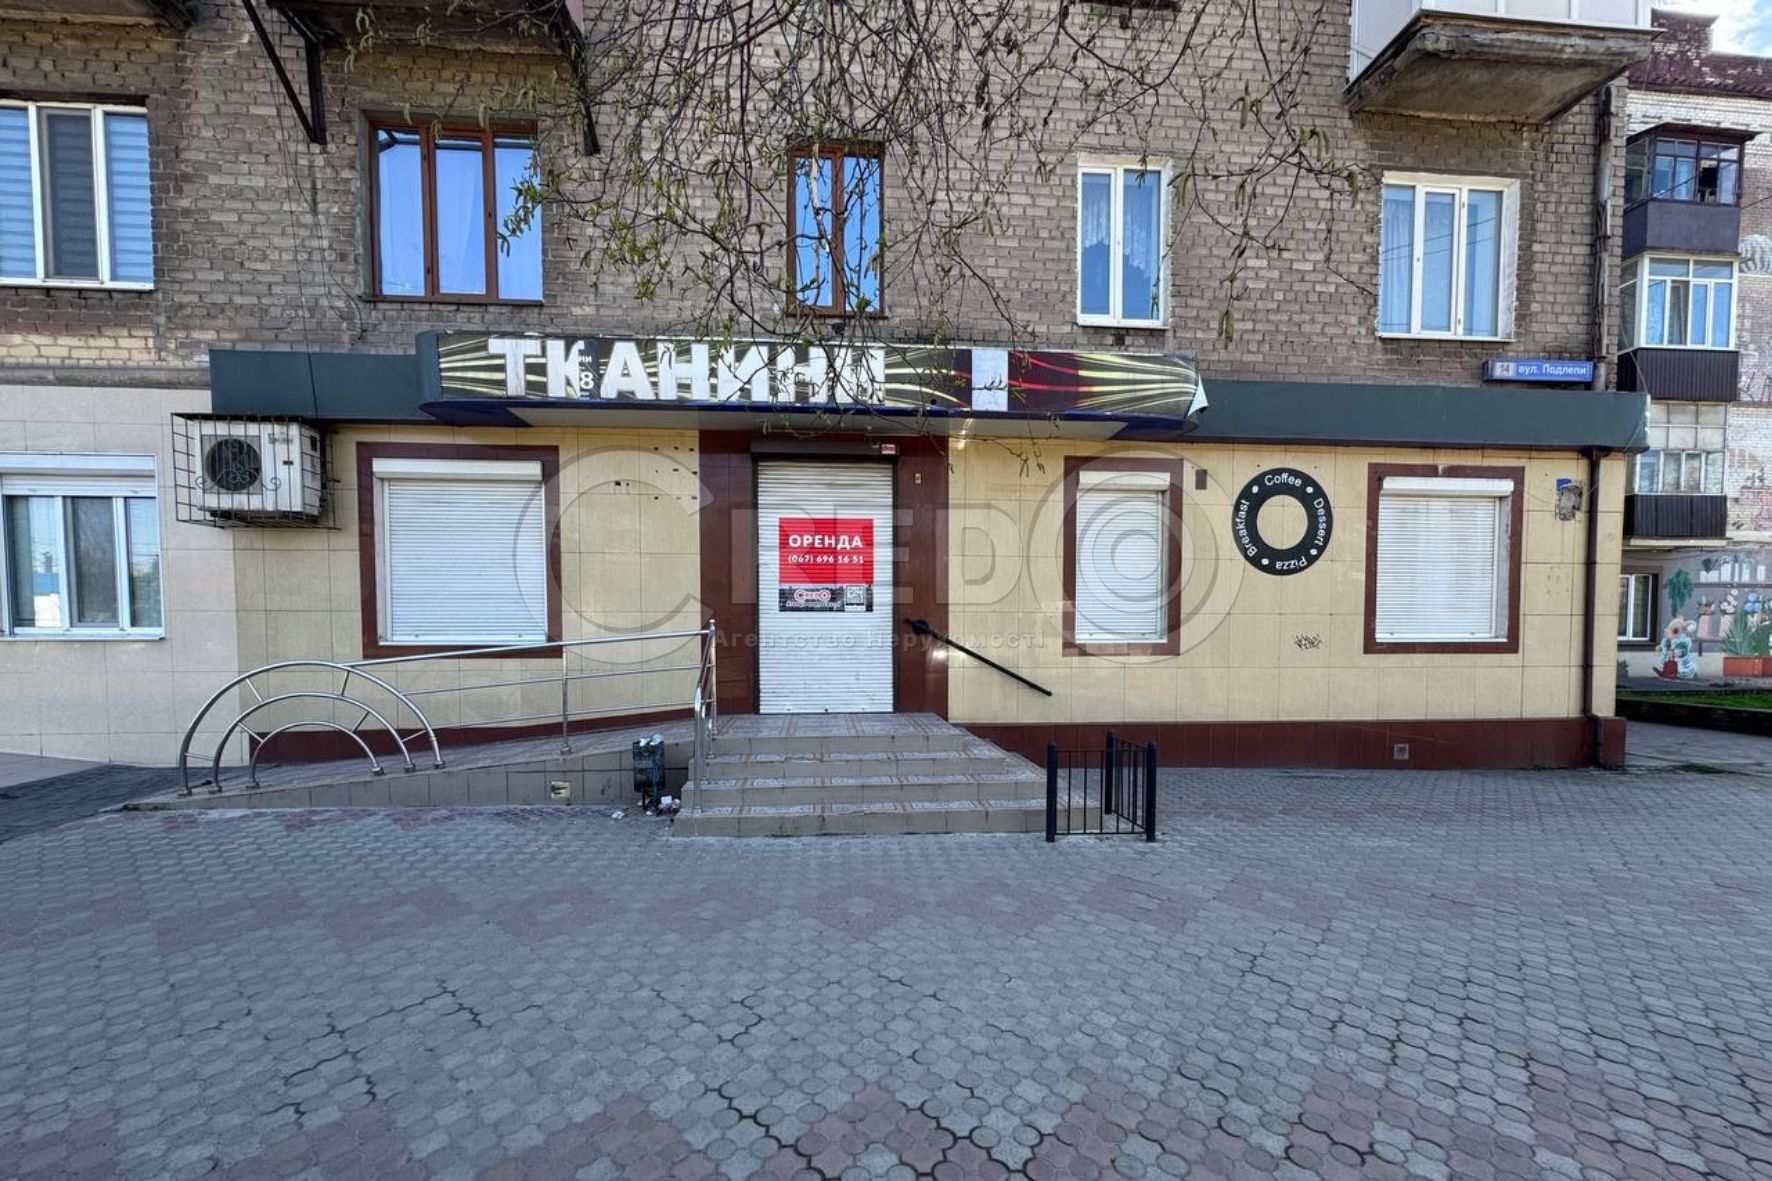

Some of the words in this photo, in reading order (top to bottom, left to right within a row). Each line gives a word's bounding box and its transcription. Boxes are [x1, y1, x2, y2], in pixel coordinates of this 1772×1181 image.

[488, 338, 885, 404] ТКАНИНИ
[1518, 364, 1540, 374] вул.
[1264, 472, 1302, 487] Coffee
[1235, 499, 1258, 557] Breakfast
[1313, 497, 1327, 546] Dessert
[788, 535, 863, 550] ОРЕНДА
[788, 555, 814, 564] (067)
[816, 555, 835, 564] 696
[838, 555, 850, 564] 16
[853, 555, 865, 564] 51
[1275, 555, 1307, 569] Pizza
